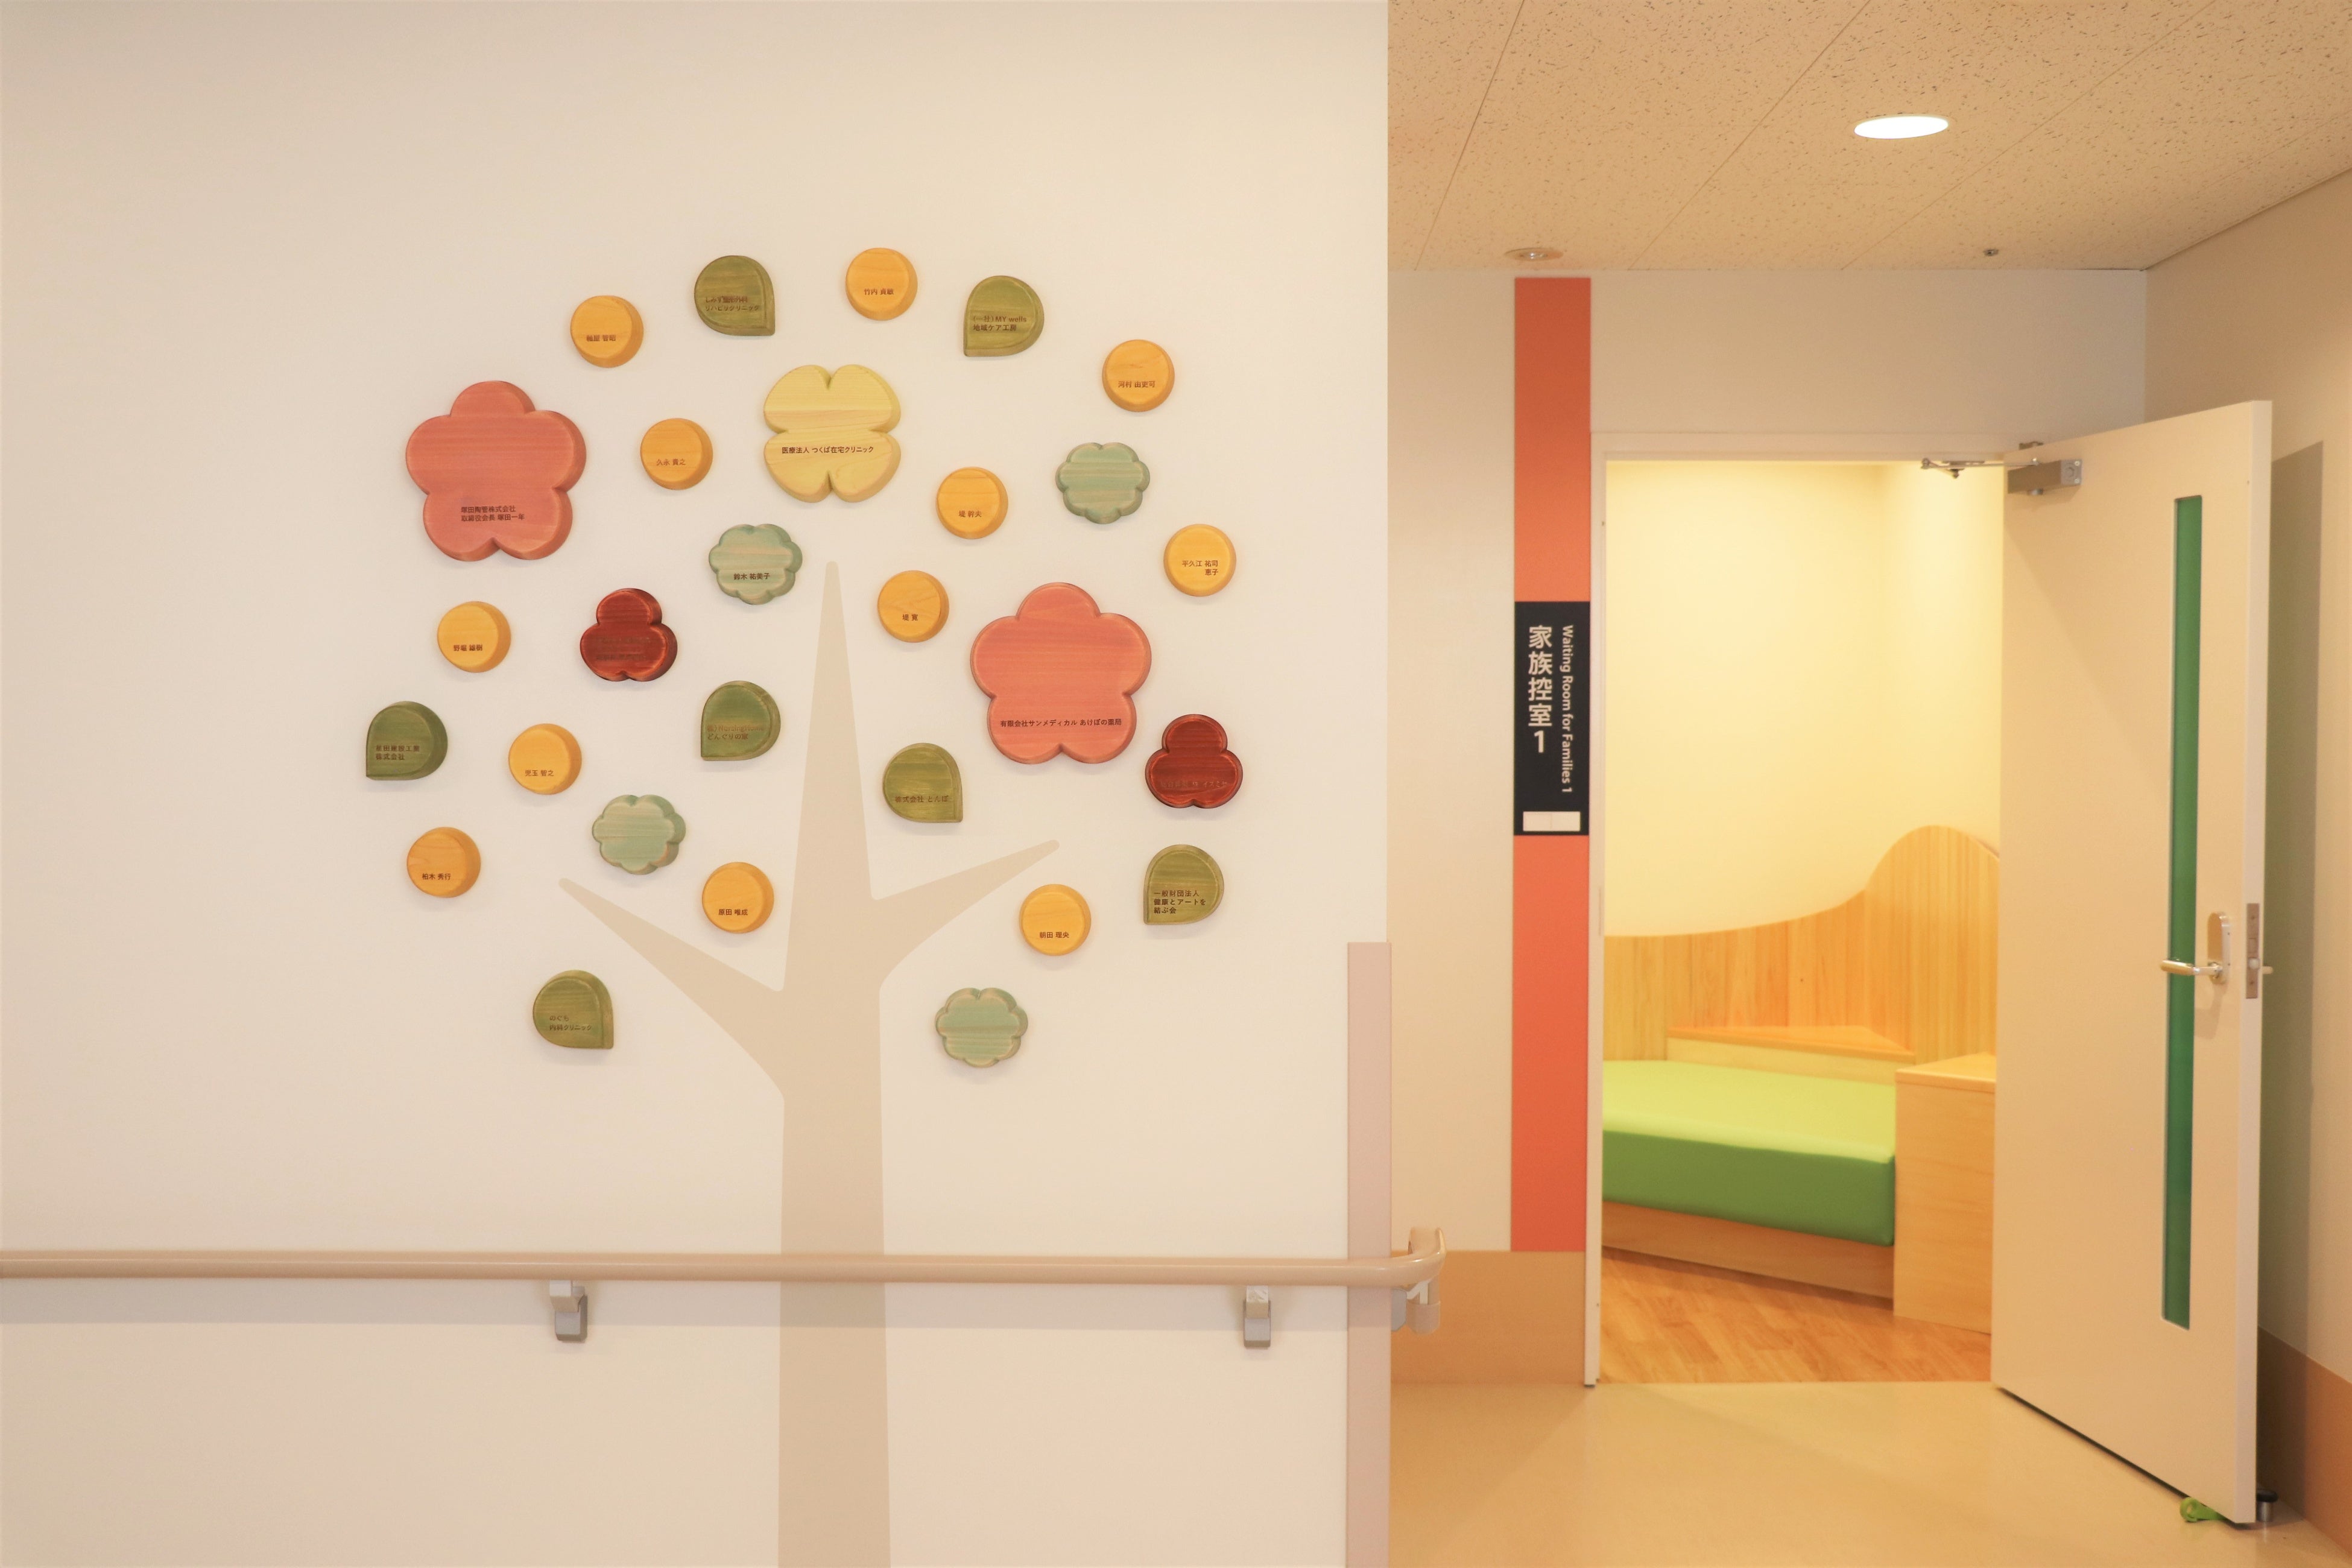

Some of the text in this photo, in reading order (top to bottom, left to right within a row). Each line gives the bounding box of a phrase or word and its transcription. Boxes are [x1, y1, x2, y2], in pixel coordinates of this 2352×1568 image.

[1560, 625, 1573, 672] Waiting
[1528, 625, 1552, 753] 家族控室1
[1562, 675, 1573, 711] Room
[1079, 718, 1122, 727] あけぼの薬局
[1562, 713, 1573, 730] for
[1561, 734, 1573, 784] Families
